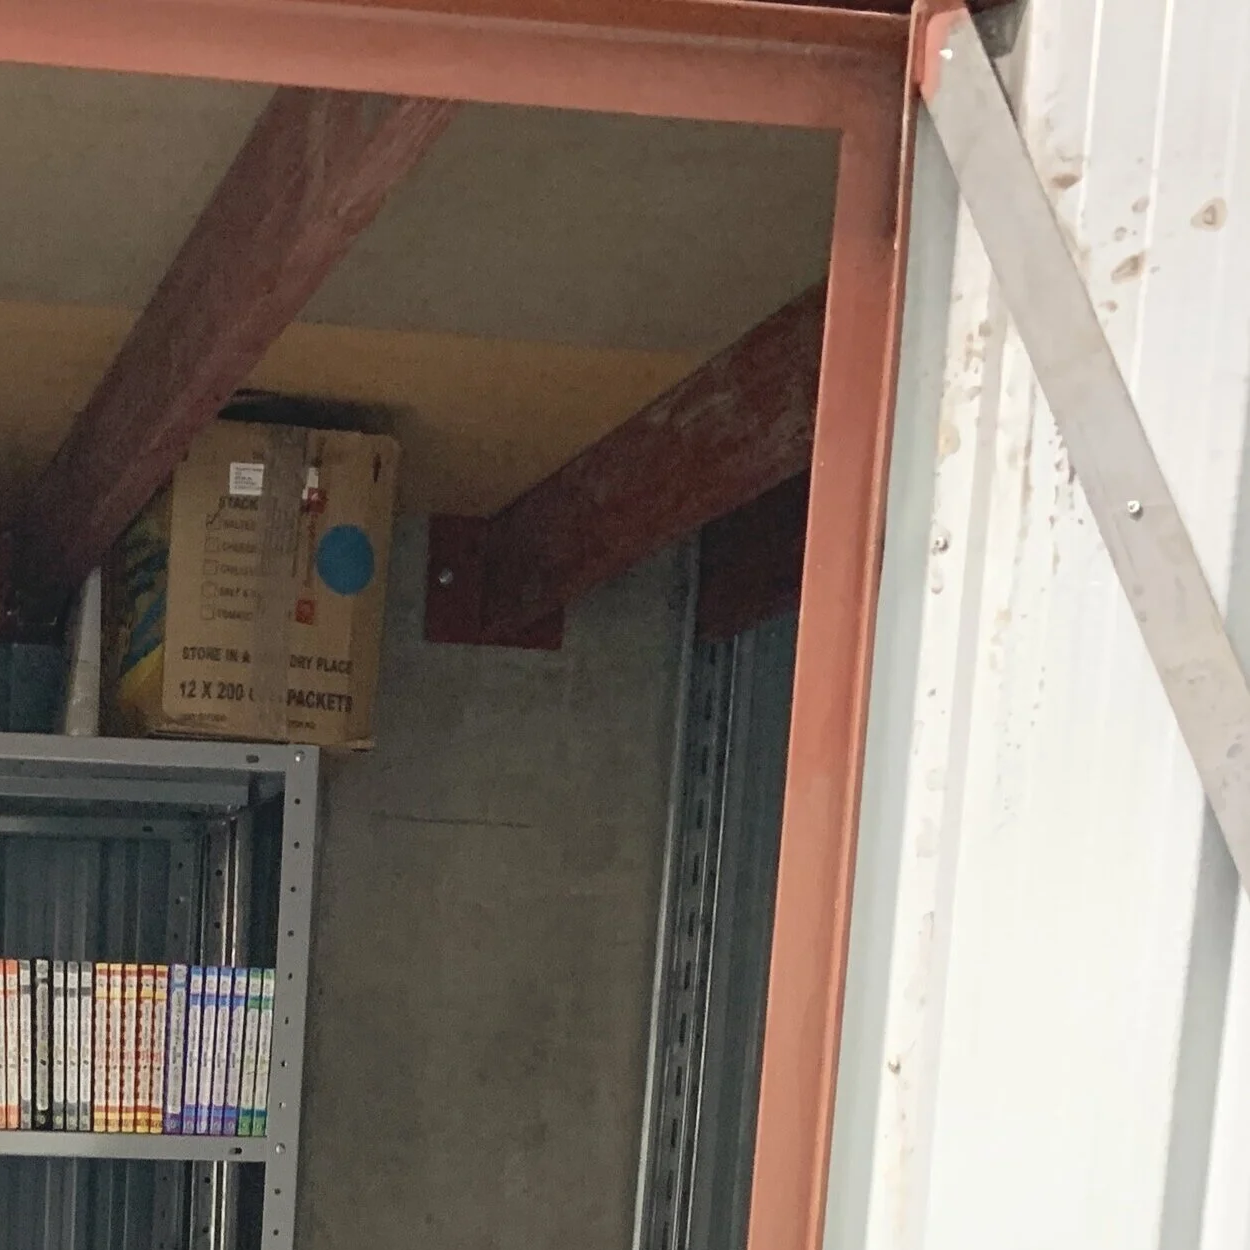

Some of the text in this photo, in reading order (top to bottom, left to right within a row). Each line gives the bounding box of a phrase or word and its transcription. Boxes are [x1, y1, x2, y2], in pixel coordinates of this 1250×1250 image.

[182, 646, 222, 661] STORE
[226, 648, 239, 662] IN
[290, 654, 354, 675] DRY PLACE
[180, 681, 196, 698] 12
[202, 682, 212, 699] X
[218, 683, 244, 701] 200
[287, 689, 354, 712] PACKETS
